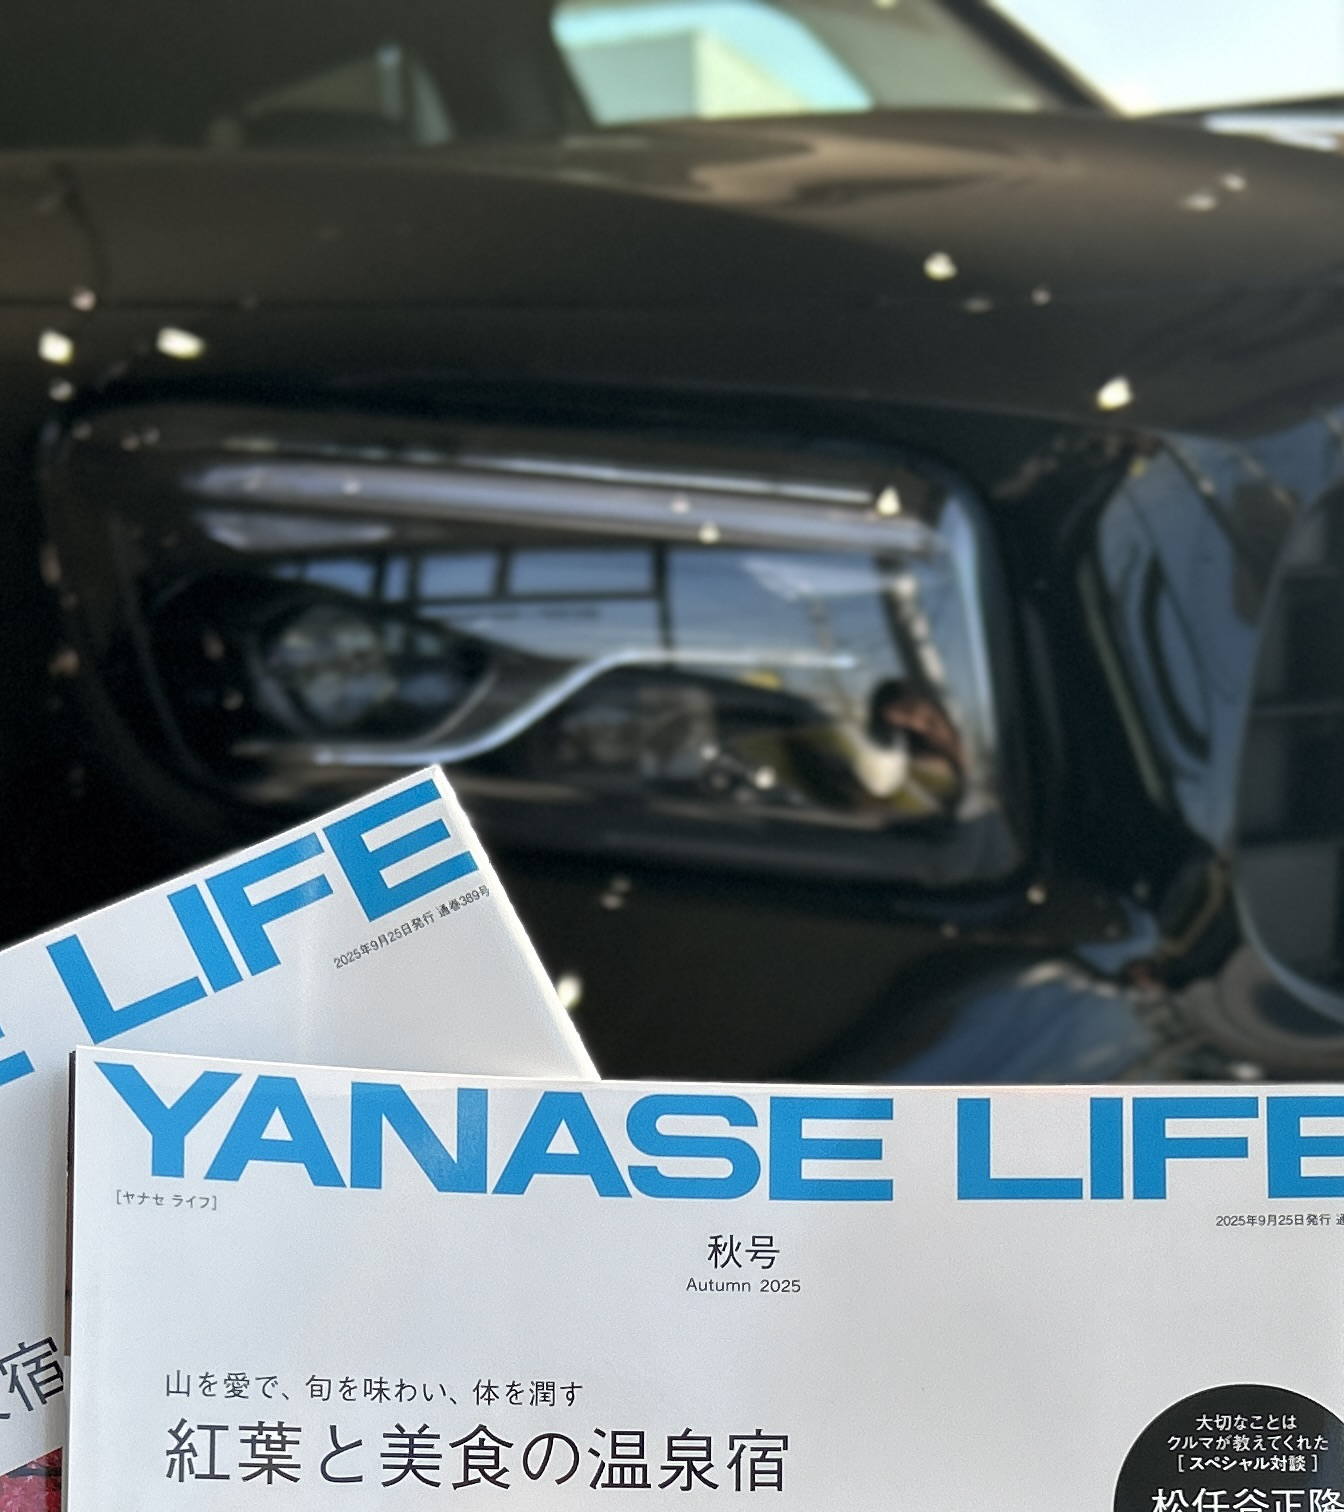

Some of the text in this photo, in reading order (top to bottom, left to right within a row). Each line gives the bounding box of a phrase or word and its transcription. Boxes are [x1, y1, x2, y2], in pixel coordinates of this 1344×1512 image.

[46, 778, 480, 1045] LIFE
[95, 1061, 894, 1201] YANASE
[1215, 1213, 1331, 1227] 2025年9月25日発行
[707, 1233, 781, 1270] 秋号
[686, 1277, 802, 1294] Autumn 2025
[165, 1370, 583, 1408] 山を愛で、旬を味わい、体を潤す
[1196, 1413, 1298, 1431] 大切なことは
[165, 1417, 790, 1492] 紅葉と美食の温泉宿
[1167, 1434, 1329, 1451] クルマが教えてくれた
